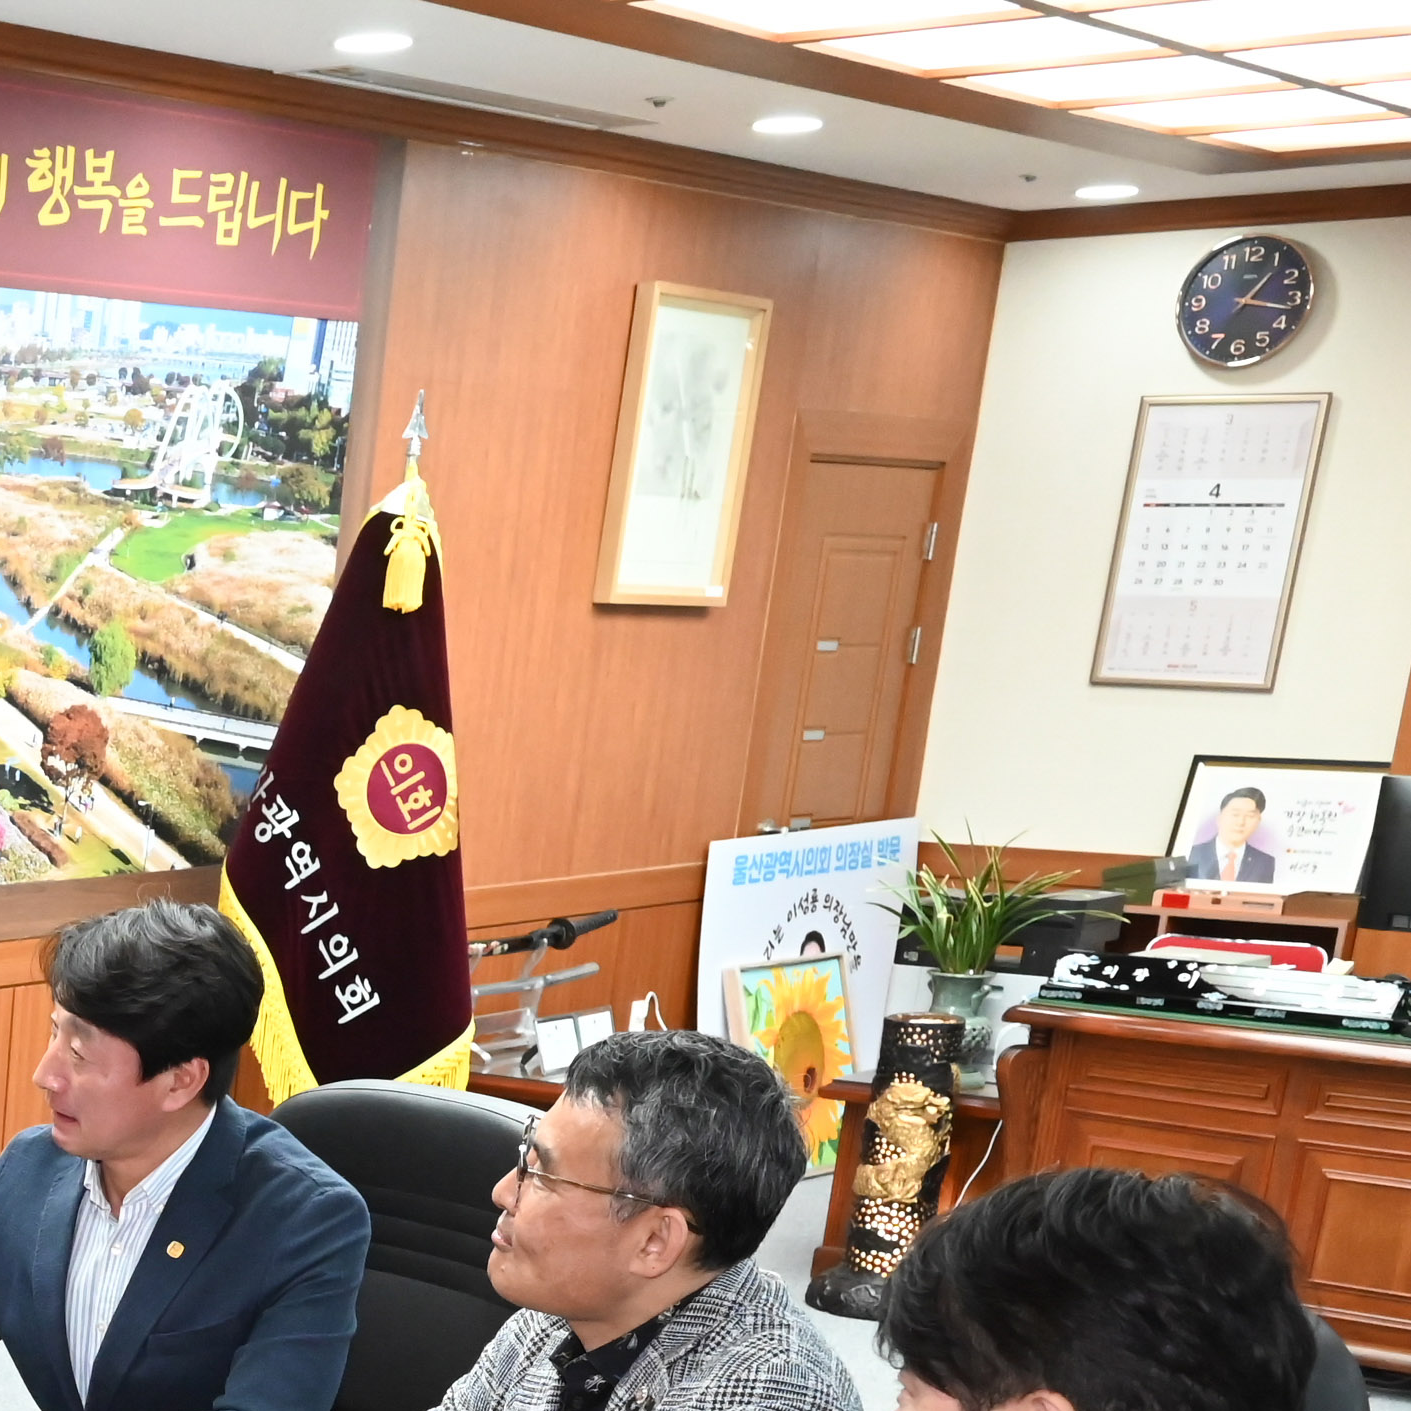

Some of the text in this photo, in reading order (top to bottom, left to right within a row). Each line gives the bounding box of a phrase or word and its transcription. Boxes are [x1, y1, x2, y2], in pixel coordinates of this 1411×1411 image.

[25, 145, 155, 236] 행복을
[159, 168, 330, 261] 드립니다
[1223, 254, 1236, 270] 11
[1244, 246, 1265, 262] 12
[1274, 252, 1279, 266] 1
[1202, 273, 1222, 289] 10
[1283, 269, 1299, 284] 2
[1191, 295, 1206, 311] 9
[1287, 291, 1301, 306] 3
[1195, 318, 1210, 334] 8
[1272, 315, 1287, 330] 4
[1211, 334, 1225, 349] 7
[1230, 339, 1246, 355] 6
[1255, 331, 1270, 347] 5
[1209, 483, 1221, 498] 4
[380, 753, 442, 831] 의회
[732, 835, 901, 886] 울산광역시의회 의장실 방문
[786, 888, 819, 923] 이성룡
